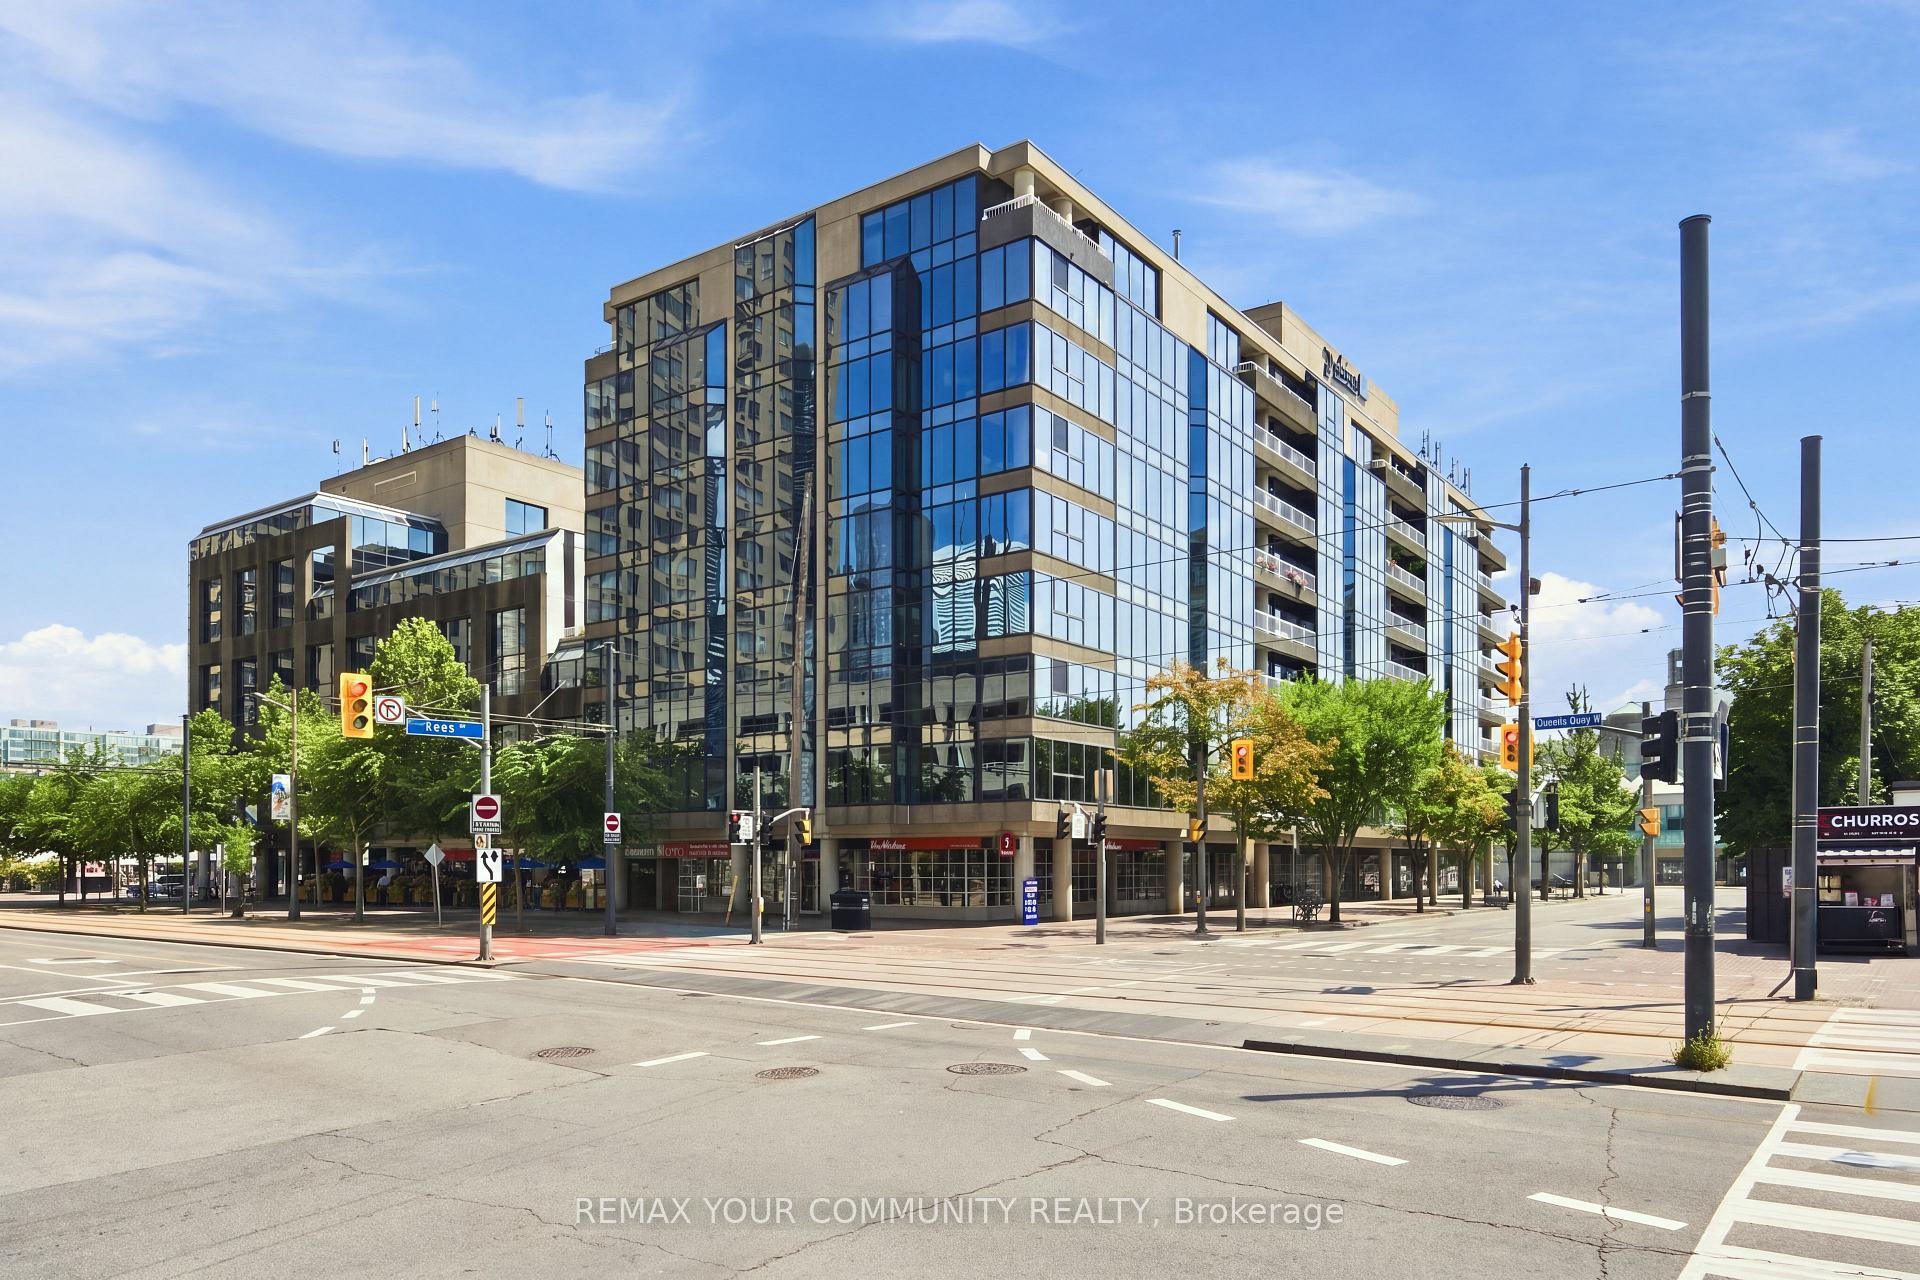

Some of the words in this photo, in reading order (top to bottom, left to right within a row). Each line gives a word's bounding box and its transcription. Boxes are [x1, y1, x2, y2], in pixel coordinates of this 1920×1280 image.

[1593, 714, 1601, 724] W
[425, 721, 455, 733] Rees
[1831, 813, 1920, 828] CHURROS
